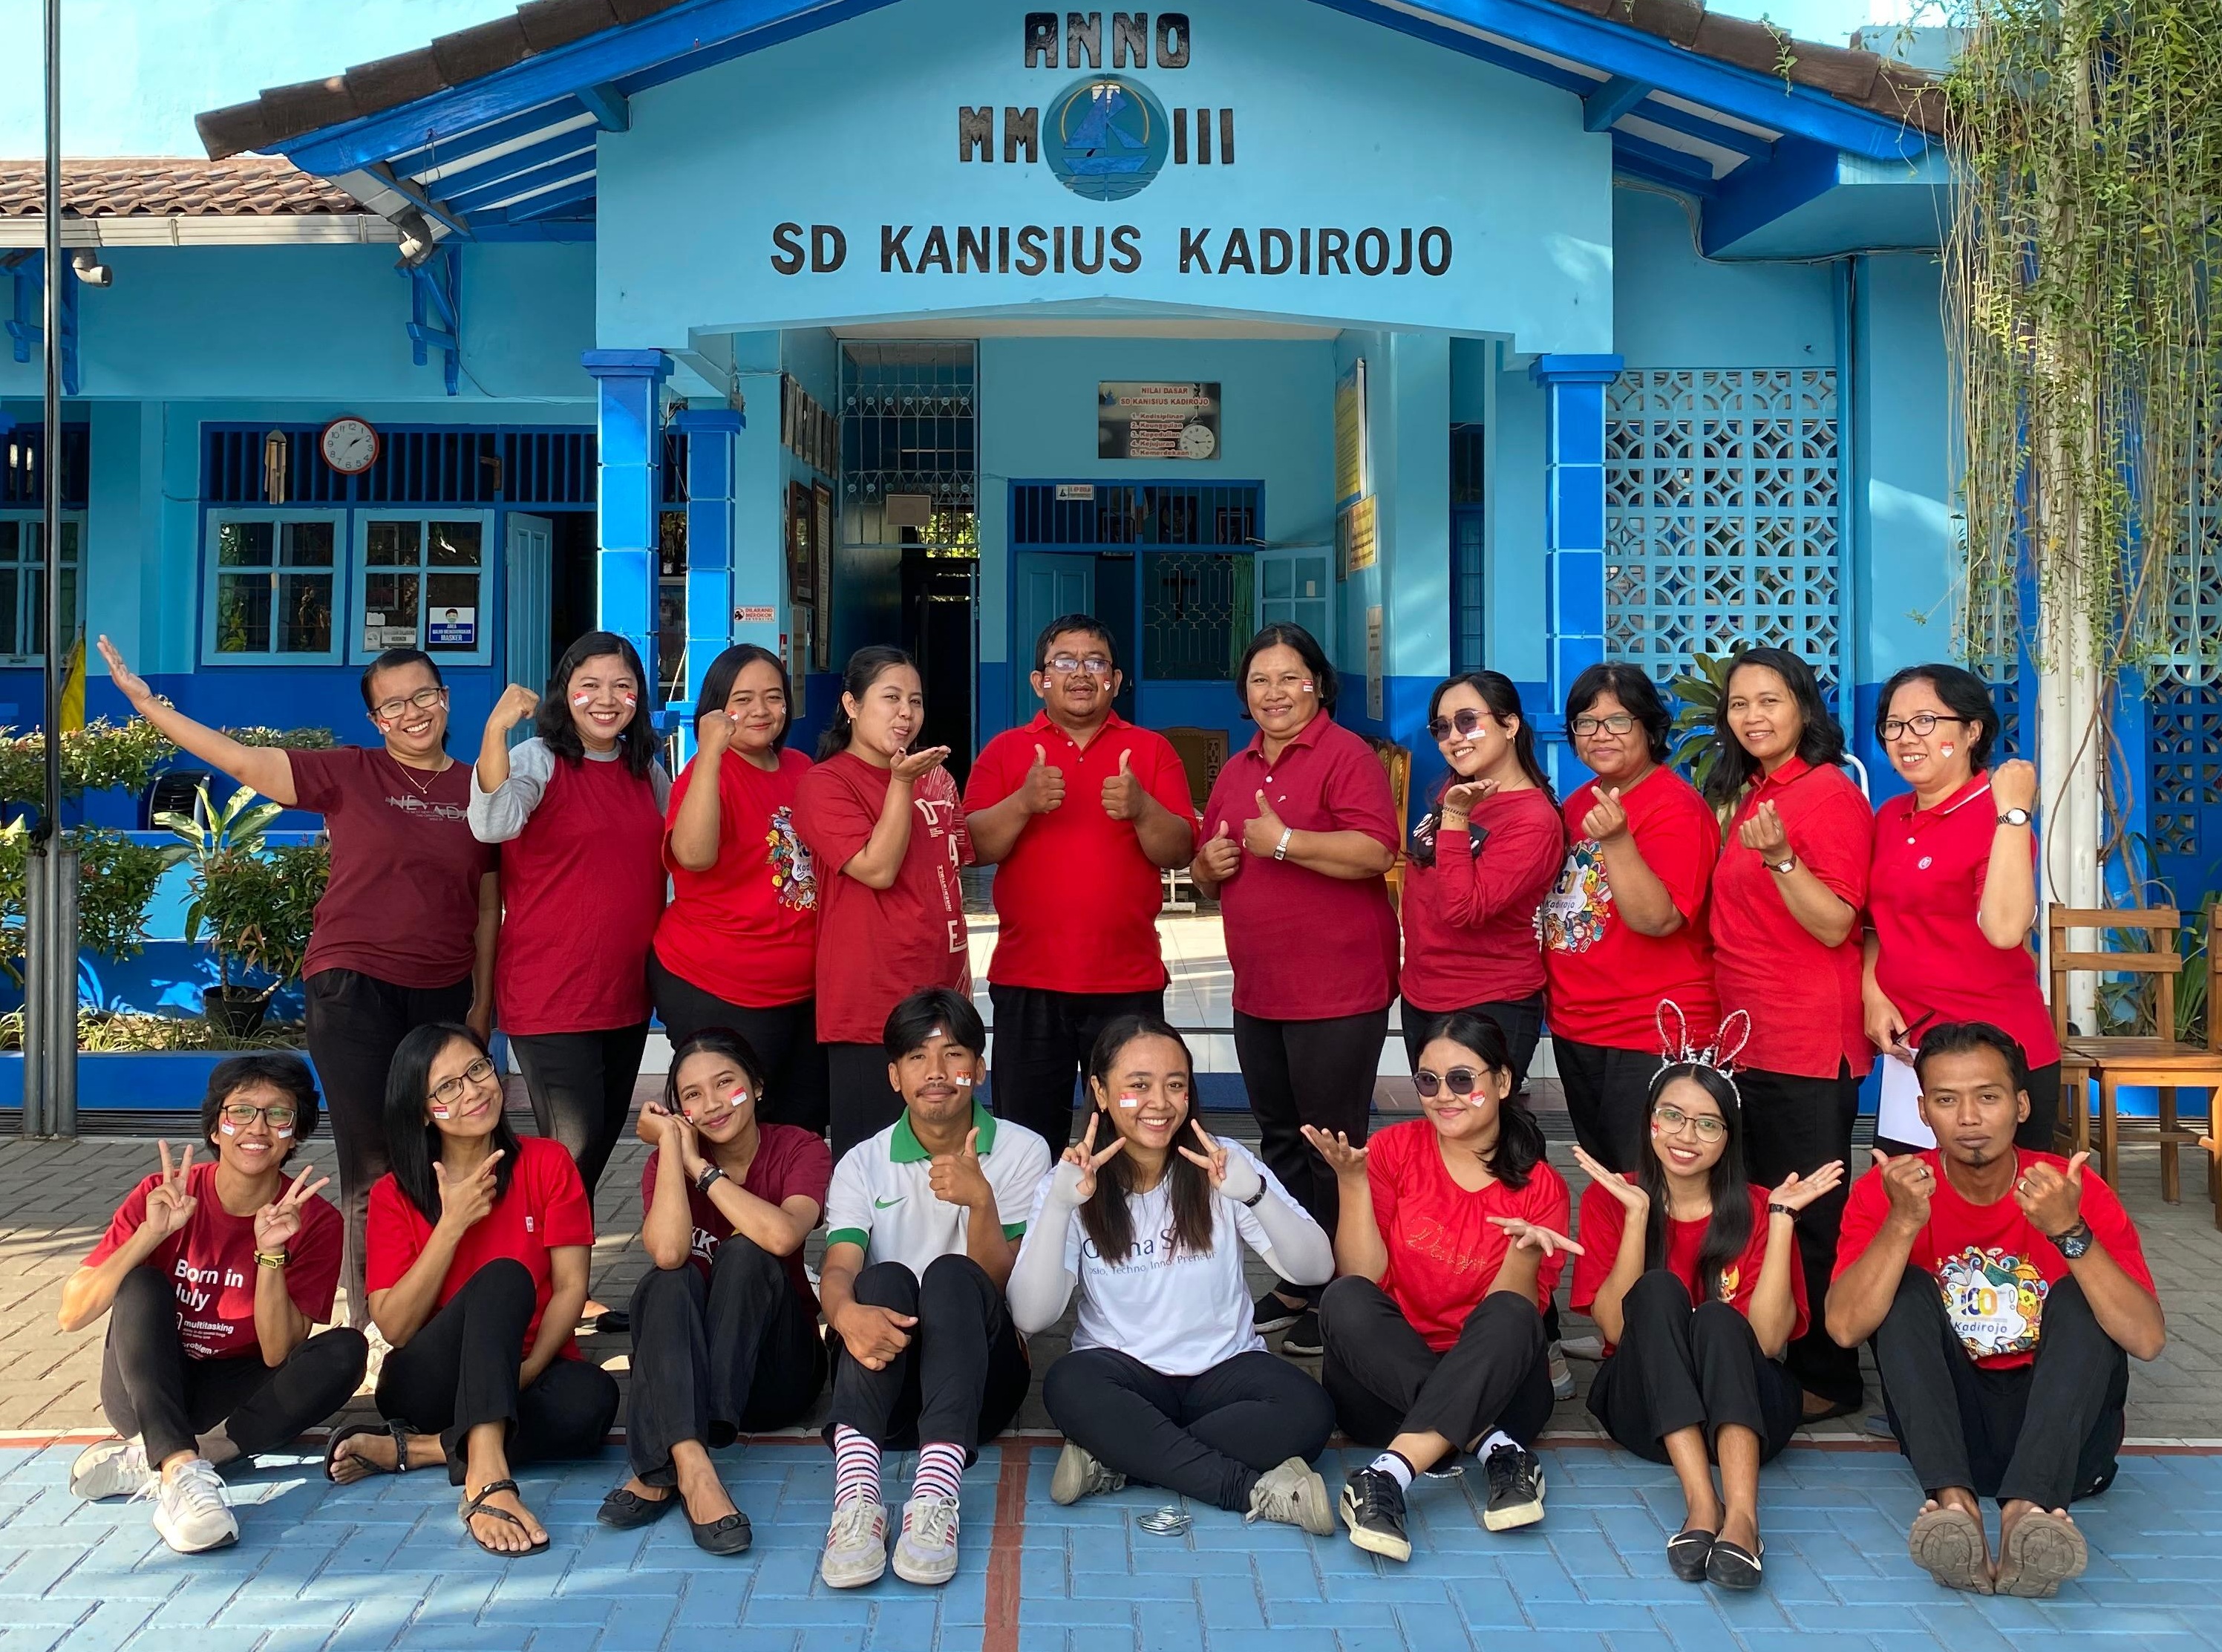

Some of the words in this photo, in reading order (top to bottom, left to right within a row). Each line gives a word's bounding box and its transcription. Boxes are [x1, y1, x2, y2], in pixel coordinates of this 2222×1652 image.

[1025, 12, 1190, 68] ANNO
[959, 106, 1038, 163] MM
[1174, 108, 1234, 164] III
[771, 223, 846, 275] SD
[881, 225, 1141, 275] KANISIUS
[1180, 226, 1451, 275] KADIROJO
[174, 1258, 218, 1284] Born
[224, 1268, 244, 1288] in
[183, 1320, 234, 1334] multitasking
[1954, 1322, 2007, 1335] Kadirojo
